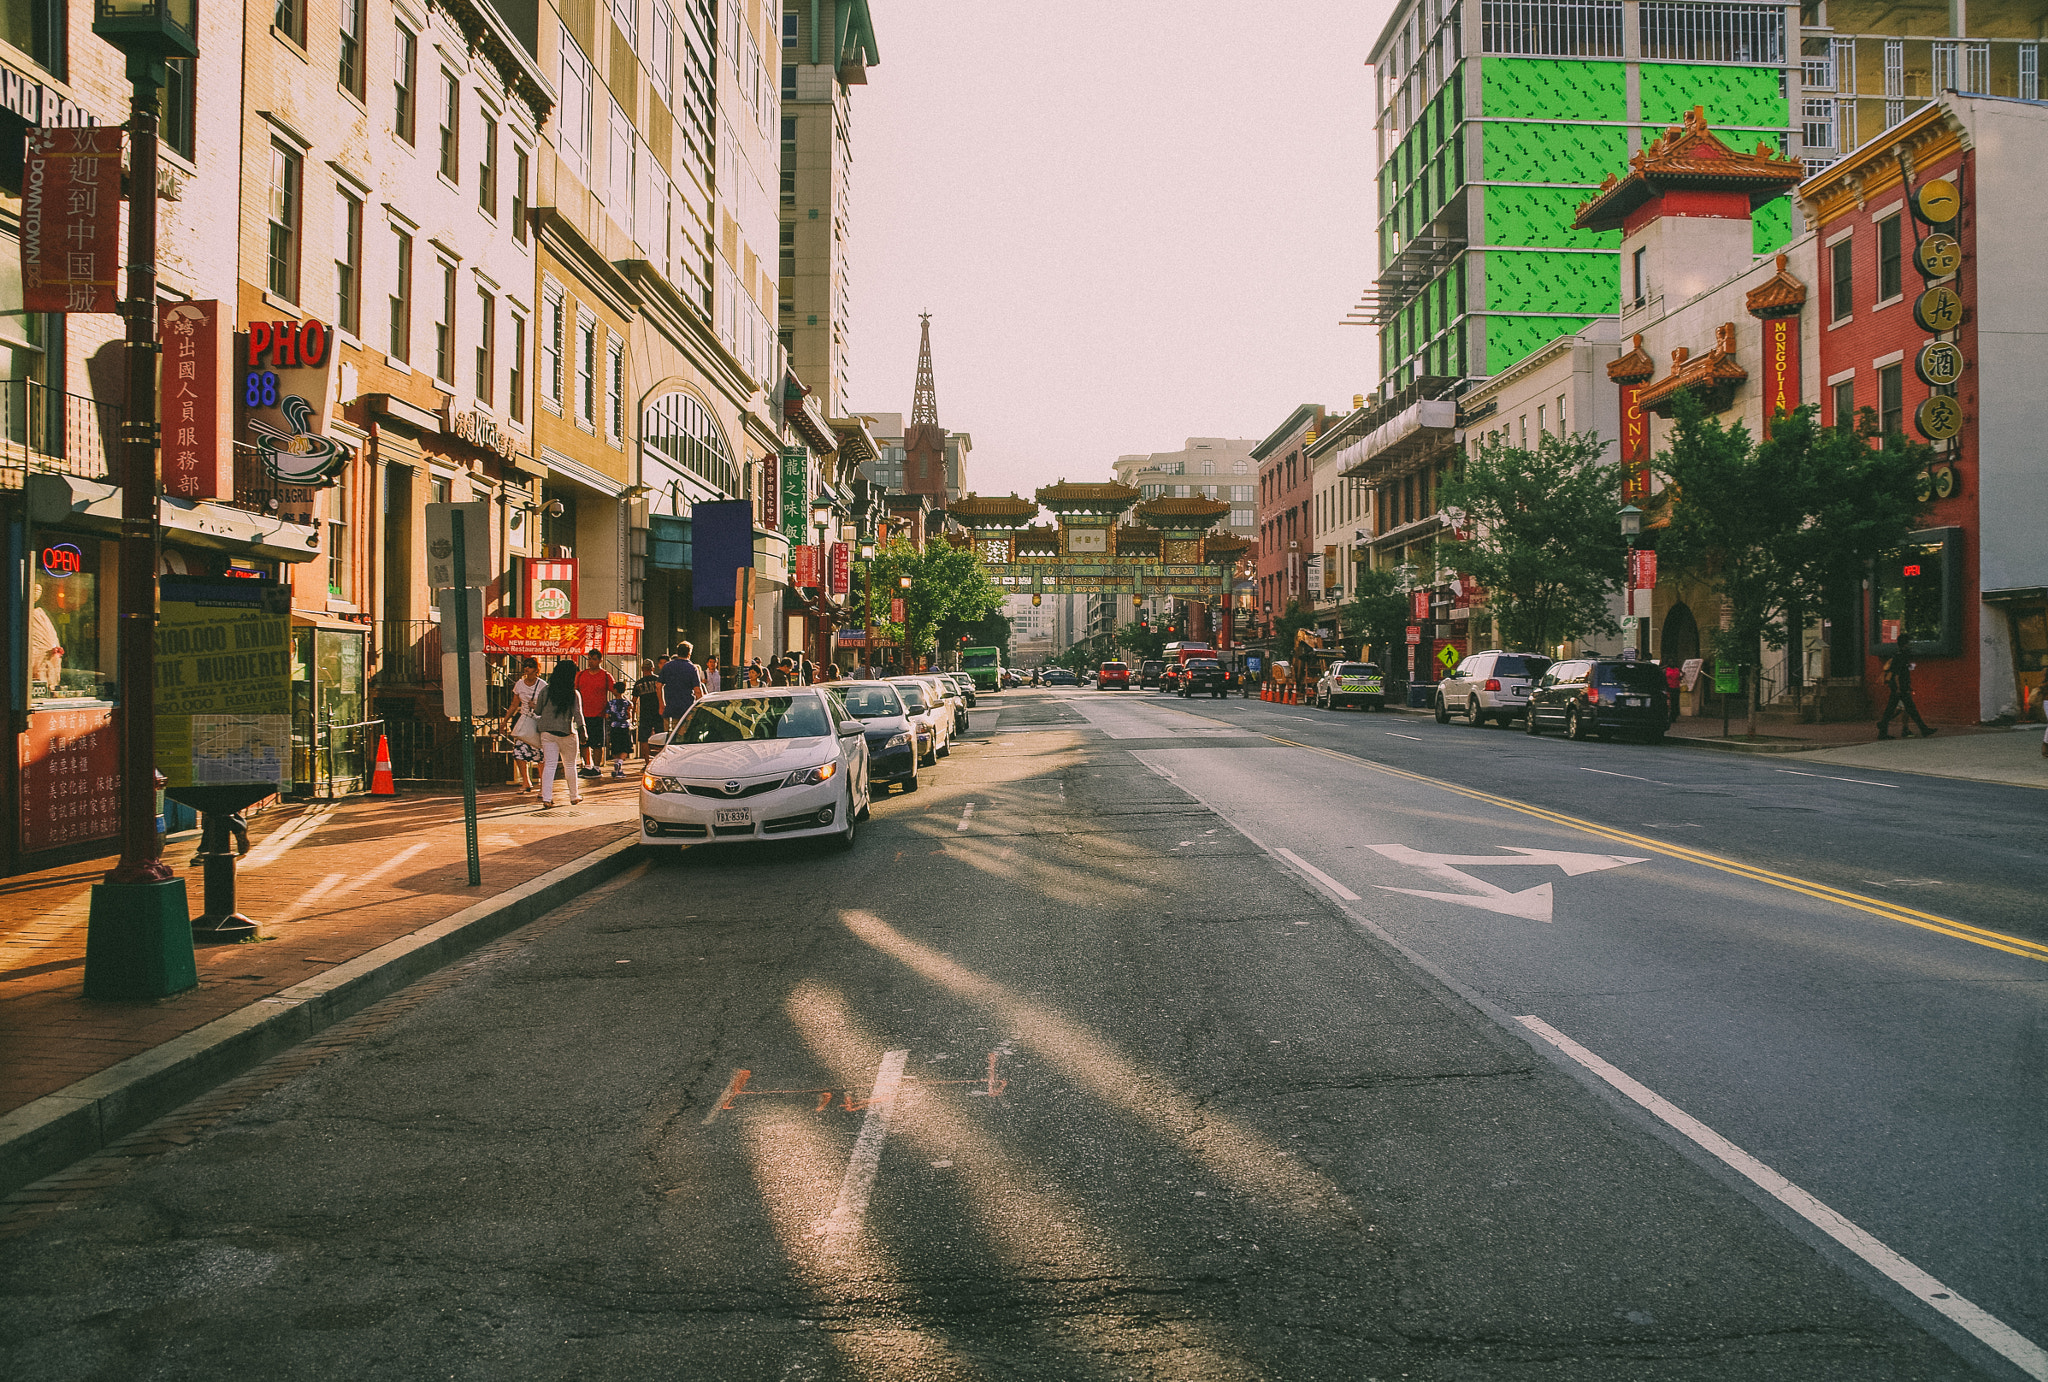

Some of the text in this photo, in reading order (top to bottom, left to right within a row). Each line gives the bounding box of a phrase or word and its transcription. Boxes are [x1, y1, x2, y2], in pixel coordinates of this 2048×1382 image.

[0, 66, 101, 128] ND RO
[65, 128, 101, 313] 欢迎到中国城
[247, 319, 325, 366] PHO
[246, 371, 276, 407] 88
[42, 547, 80, 573] OPEN
[510, 645, 546, 653] Restaurant
[224, 689, 289, 707] REWARD
